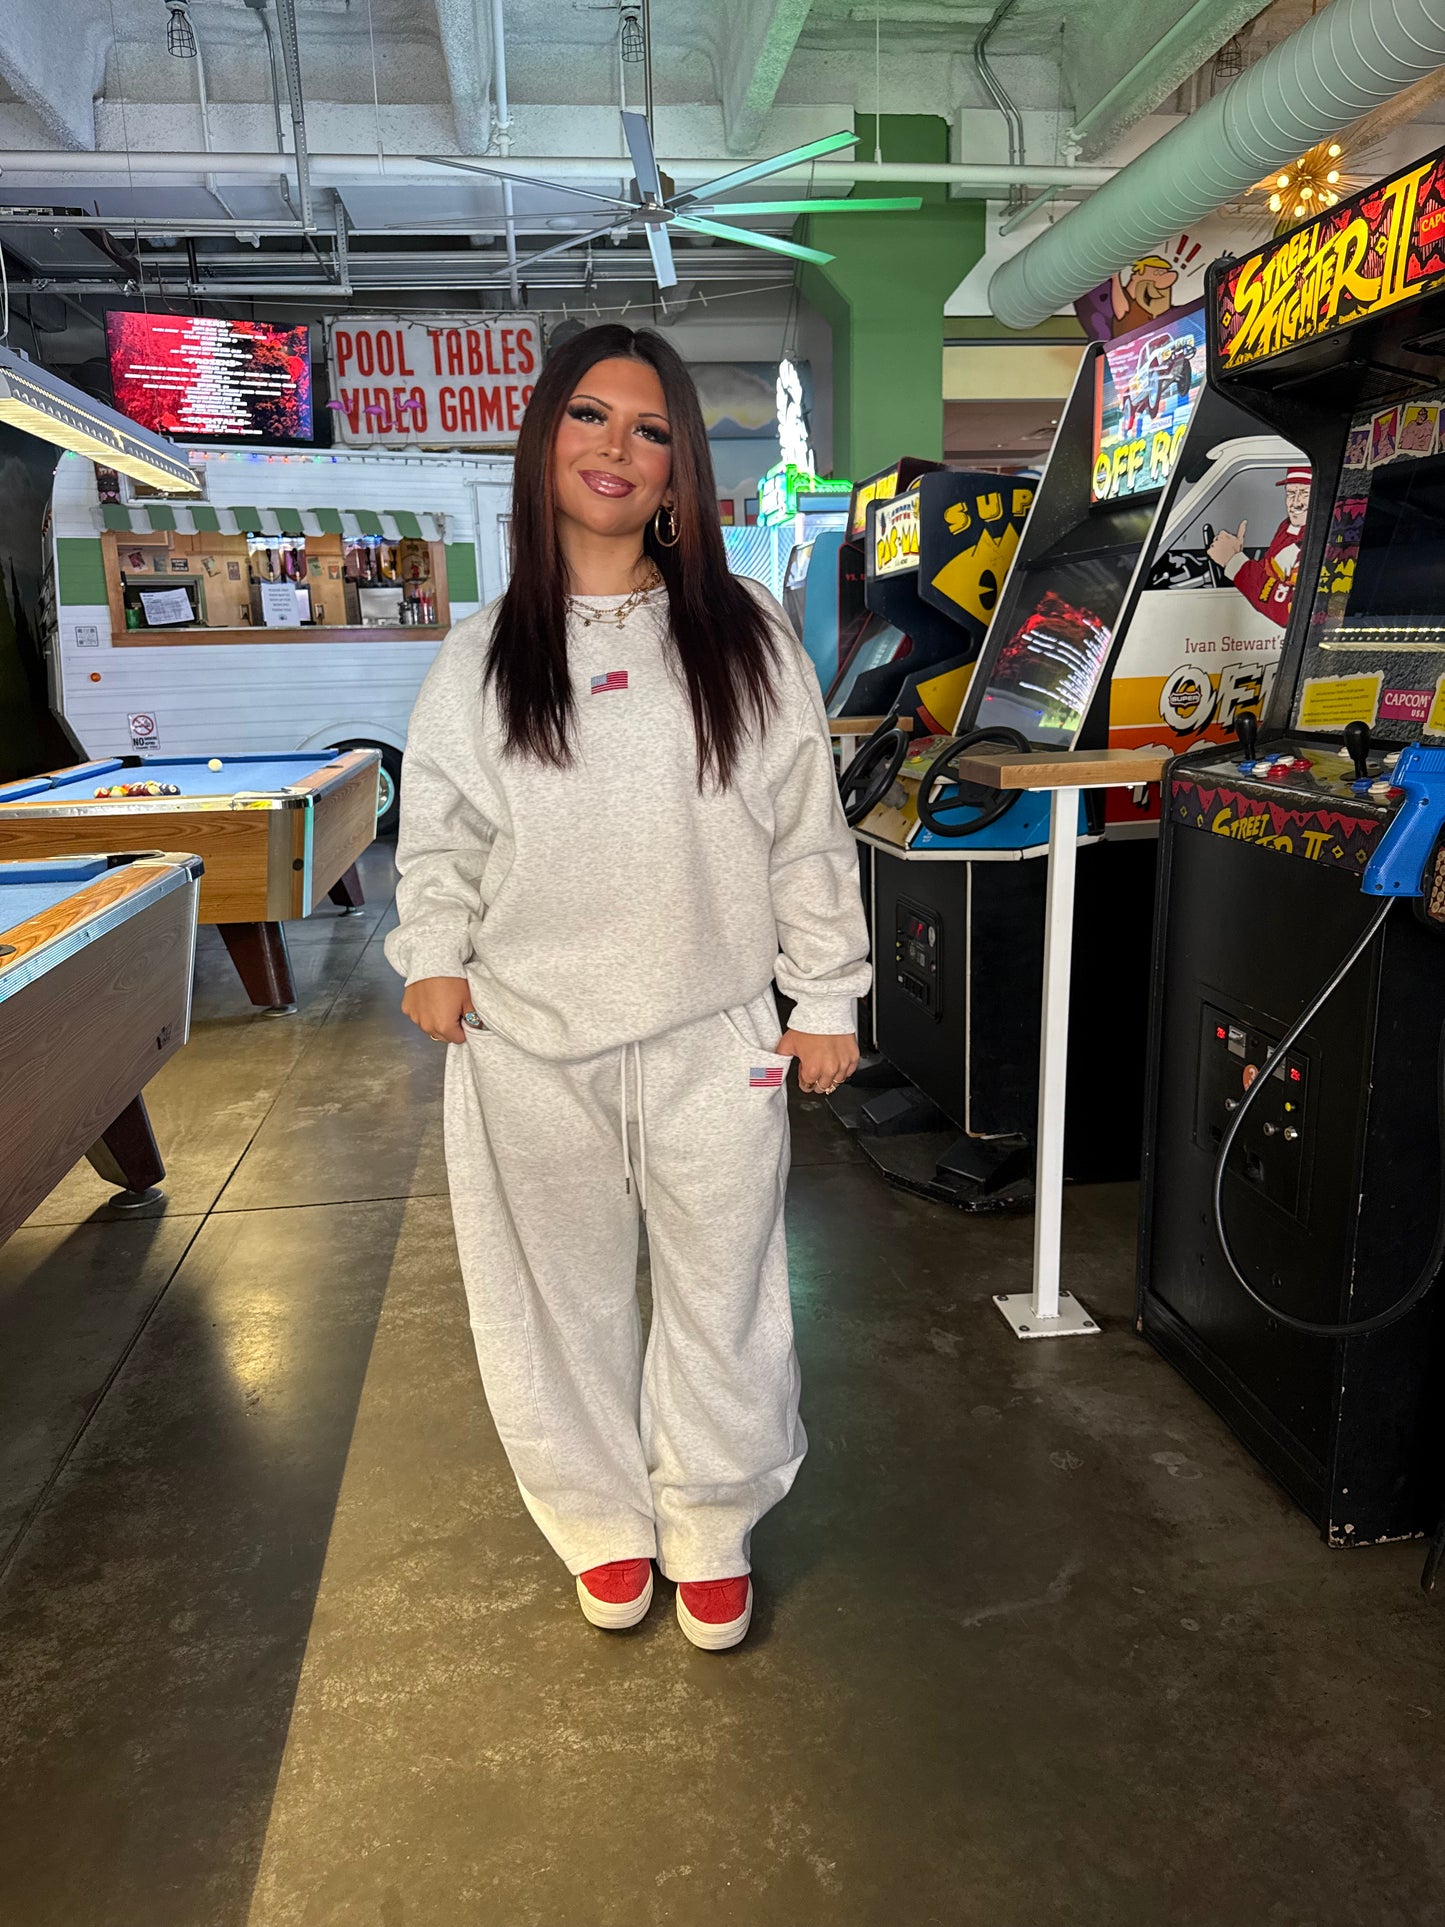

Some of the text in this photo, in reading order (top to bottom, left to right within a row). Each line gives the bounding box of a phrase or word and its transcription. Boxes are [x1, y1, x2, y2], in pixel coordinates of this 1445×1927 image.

[1247, 160, 1436, 355] FIGHTER II
[1223, 222, 1320, 368] STREET
[335, 328, 535, 377] POOL TABLES
[339, 386, 428, 434] VIDEO
[1092, 438, 1146, 500] OFF
[1185, 638, 1216, 654] Ivan
[1170, 695, 1199, 703] SUPER
[1384, 692, 1428, 708] CAPCOM
[1410, 709, 1426, 718] USA
[133, 737, 145, 746] NO
[1212, 808, 1270, 841] STREET
